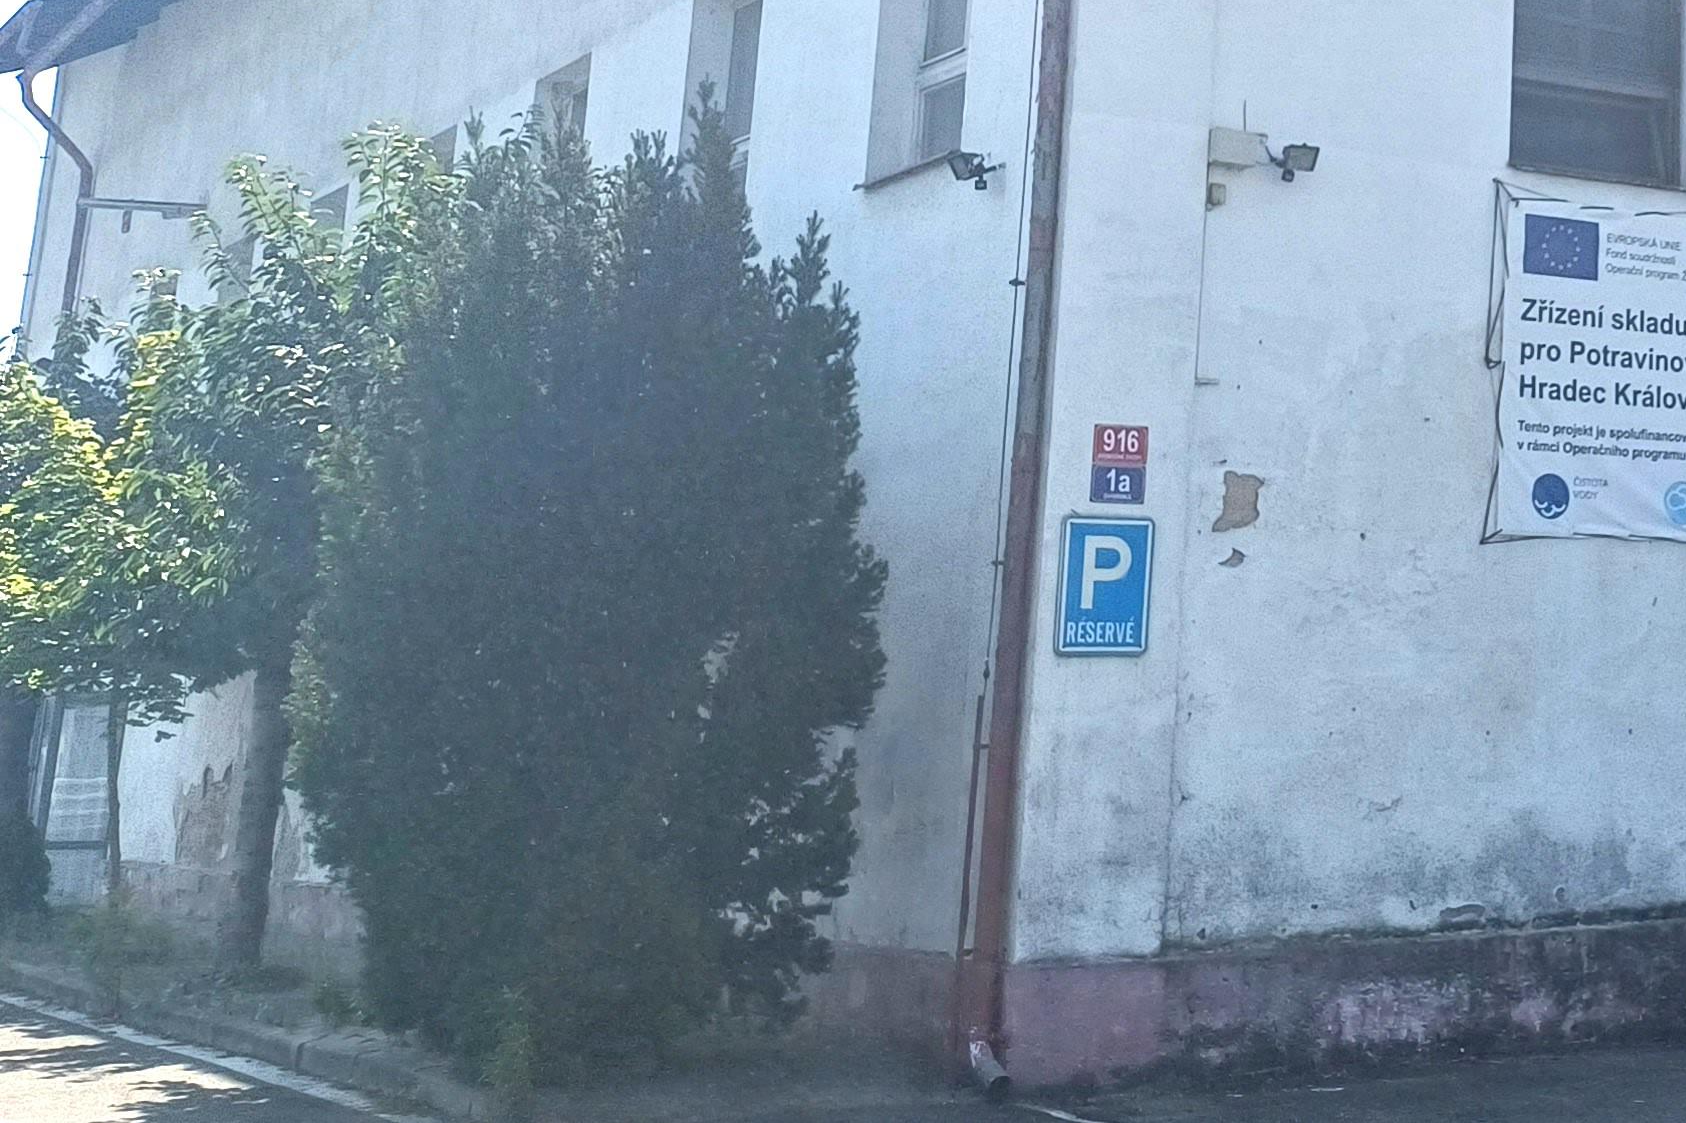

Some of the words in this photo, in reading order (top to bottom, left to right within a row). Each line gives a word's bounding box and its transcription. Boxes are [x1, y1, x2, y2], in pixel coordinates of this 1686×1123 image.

[1606, 233, 1658, 248] EVROPSKÁ
[1659, 241, 1682, 252] UNIE
[1605, 248, 1628, 260] Fond
[1629, 252, 1676, 266] soudržnosti
[1604, 262, 1644, 276] Operační
[1645, 268, 1679, 282] program
[1520, 298, 1604, 328] Zřízení
[1520, 342, 1561, 365] pro
[1519, 374, 1606, 404] Hradec
[1103, 428, 1139, 453] 916
[1518, 420, 1550, 434] Tento
[1553, 424, 1593, 439] projekt
[1595, 427, 1606, 440] je
[1517, 441, 1525, 450] v
[1527, 439, 1560, 452] rámci
[1563, 441, 1629, 458] Operačního
[1632, 448, 1686, 462] programu
[1106, 467, 1130, 492] 1a
[1573, 476, 1609, 487] ČISTOTA
[1573, 491, 1598, 500] VODY
[1080, 535, 1131, 609] P
[1066, 616, 1135, 644] RÉSERVÉ
